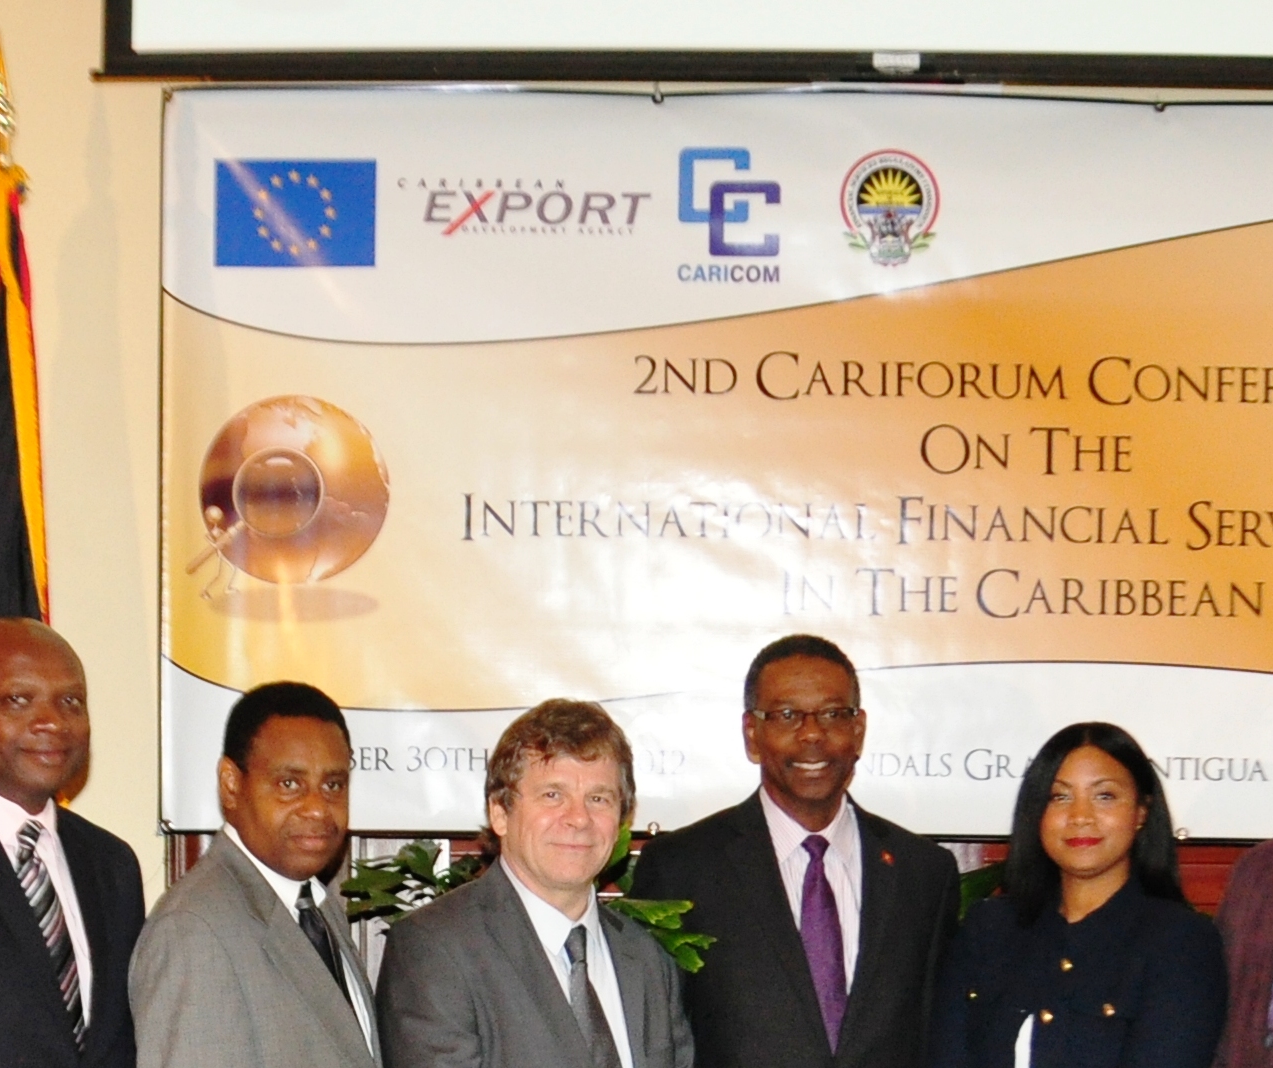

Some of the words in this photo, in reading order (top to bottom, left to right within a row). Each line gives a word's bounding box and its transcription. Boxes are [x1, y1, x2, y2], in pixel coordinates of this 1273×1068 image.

[397, 178, 564, 189] CARIBBEAN
[423, 190, 651, 234] EXPORT
[677, 264, 781, 283] CARICOM
[633, 354, 738, 395] 2ND
[755, 351, 1067, 401] CARIFORUM
[920, 423, 1010, 475] ON
[1029, 427, 1133, 476] THE
[461, 493, 877, 542] INTERNATIONAL
[895, 496, 1170, 545] FINANCIAL
[783, 569, 834, 616] IN
[855, 567, 959, 617] THE
[976, 568, 1265, 619] CARIBBEAN
[407, 745, 489, 772] 30TH
[637, 748, 686, 775] 012
[862, 752, 952, 778] NDALS
[1148, 757, 1269, 783] NTIGUA
